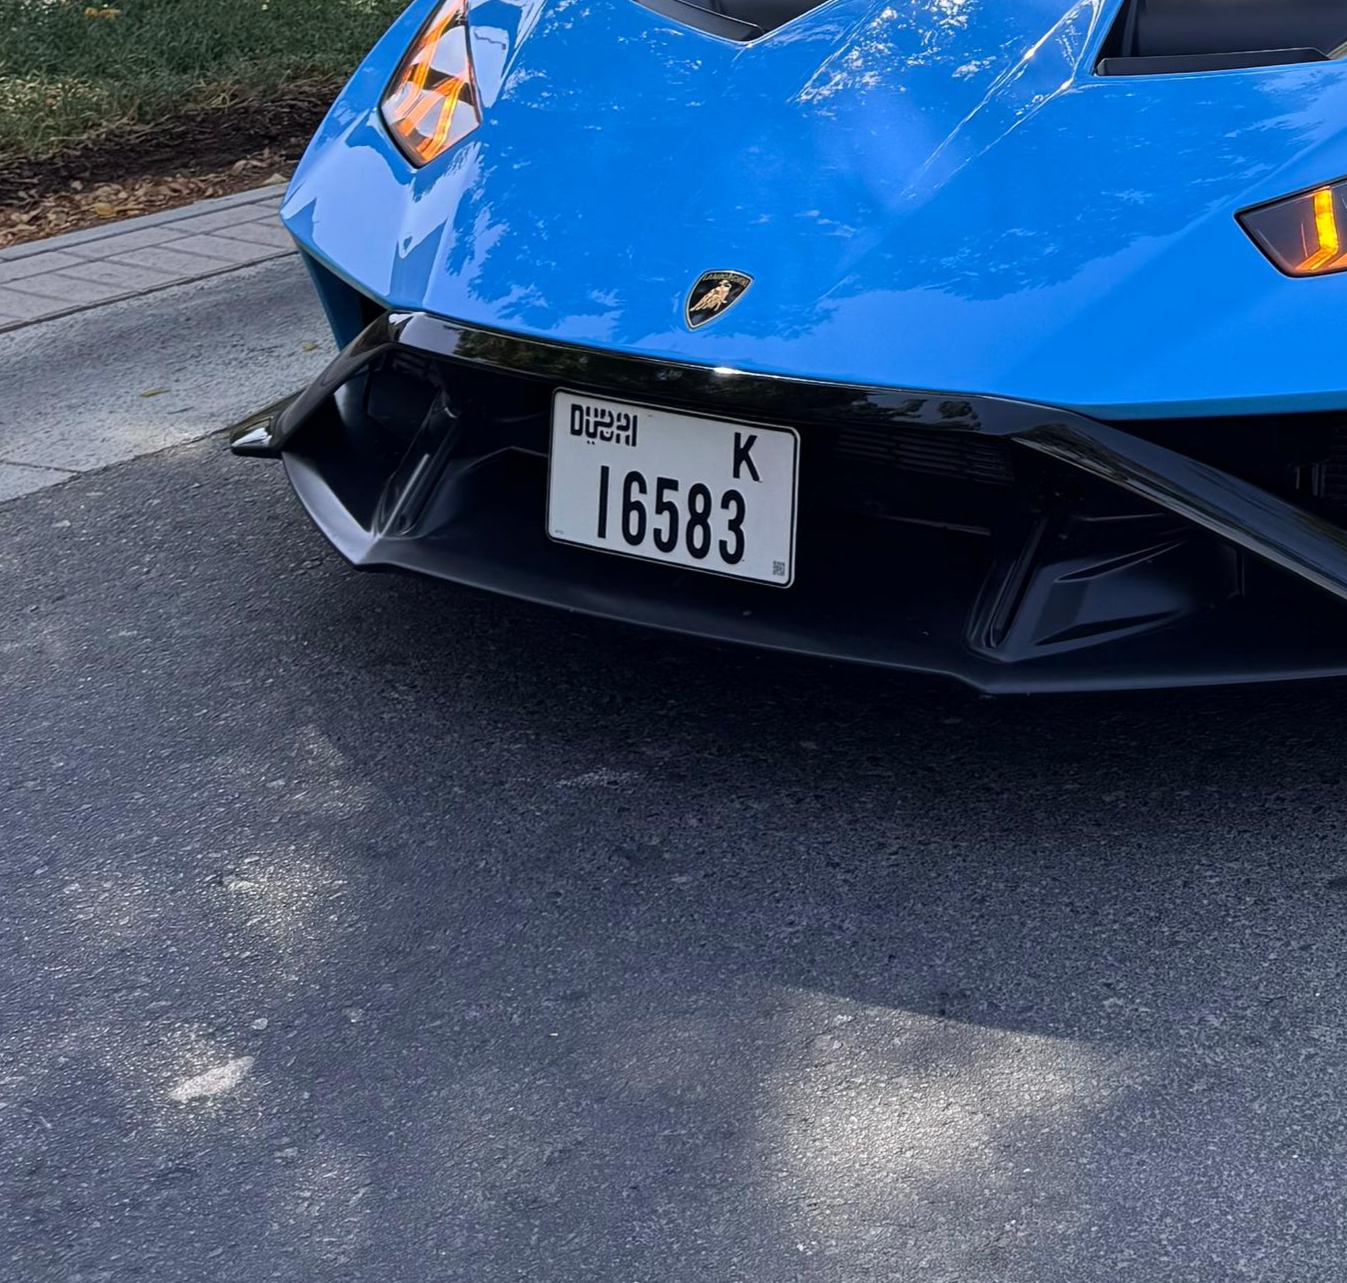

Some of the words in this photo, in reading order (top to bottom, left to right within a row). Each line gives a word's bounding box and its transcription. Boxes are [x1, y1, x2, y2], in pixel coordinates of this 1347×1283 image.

[570, 403, 638, 447] DUBAI
[732, 432, 761, 482] K
[597, 465, 746, 565] 16583
